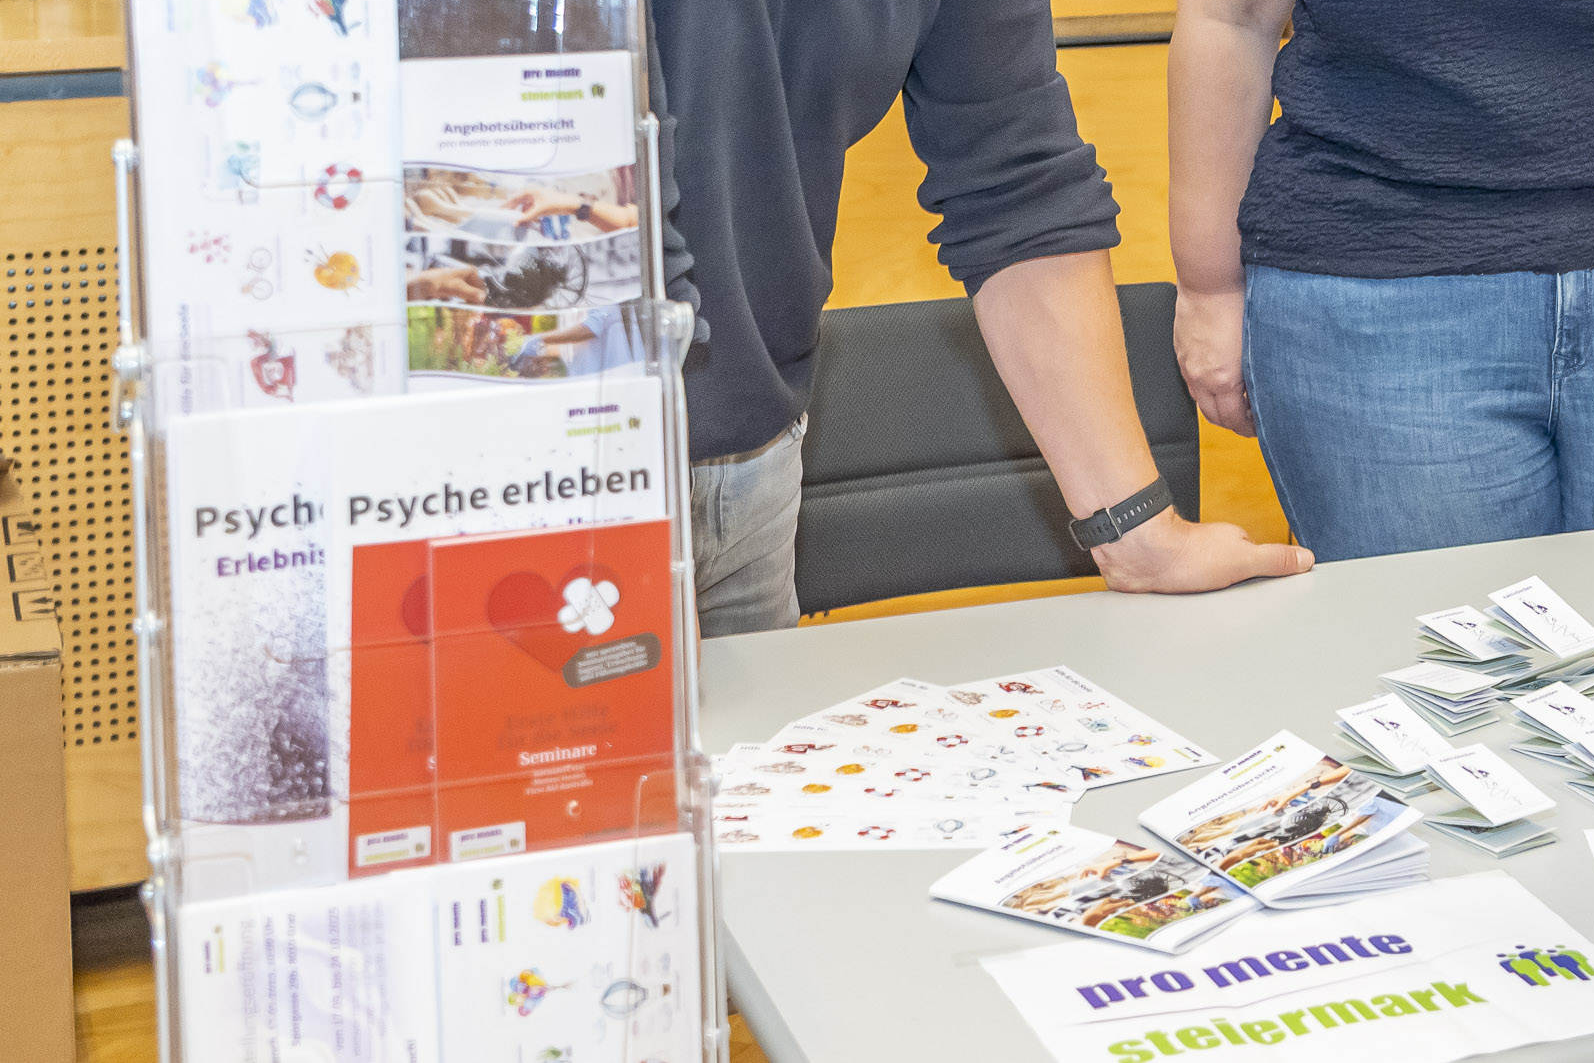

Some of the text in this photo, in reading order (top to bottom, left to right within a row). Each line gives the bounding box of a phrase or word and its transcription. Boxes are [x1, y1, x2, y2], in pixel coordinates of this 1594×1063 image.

[443, 118, 576, 137] Angebotsübersicht
[349, 482, 490, 529] Psyche
[501, 466, 651, 507] erleben
[518, 743, 598, 766] Seminare
[1075, 932, 1413, 1010] pro mente
[1105, 979, 1489, 1063] steiermark
